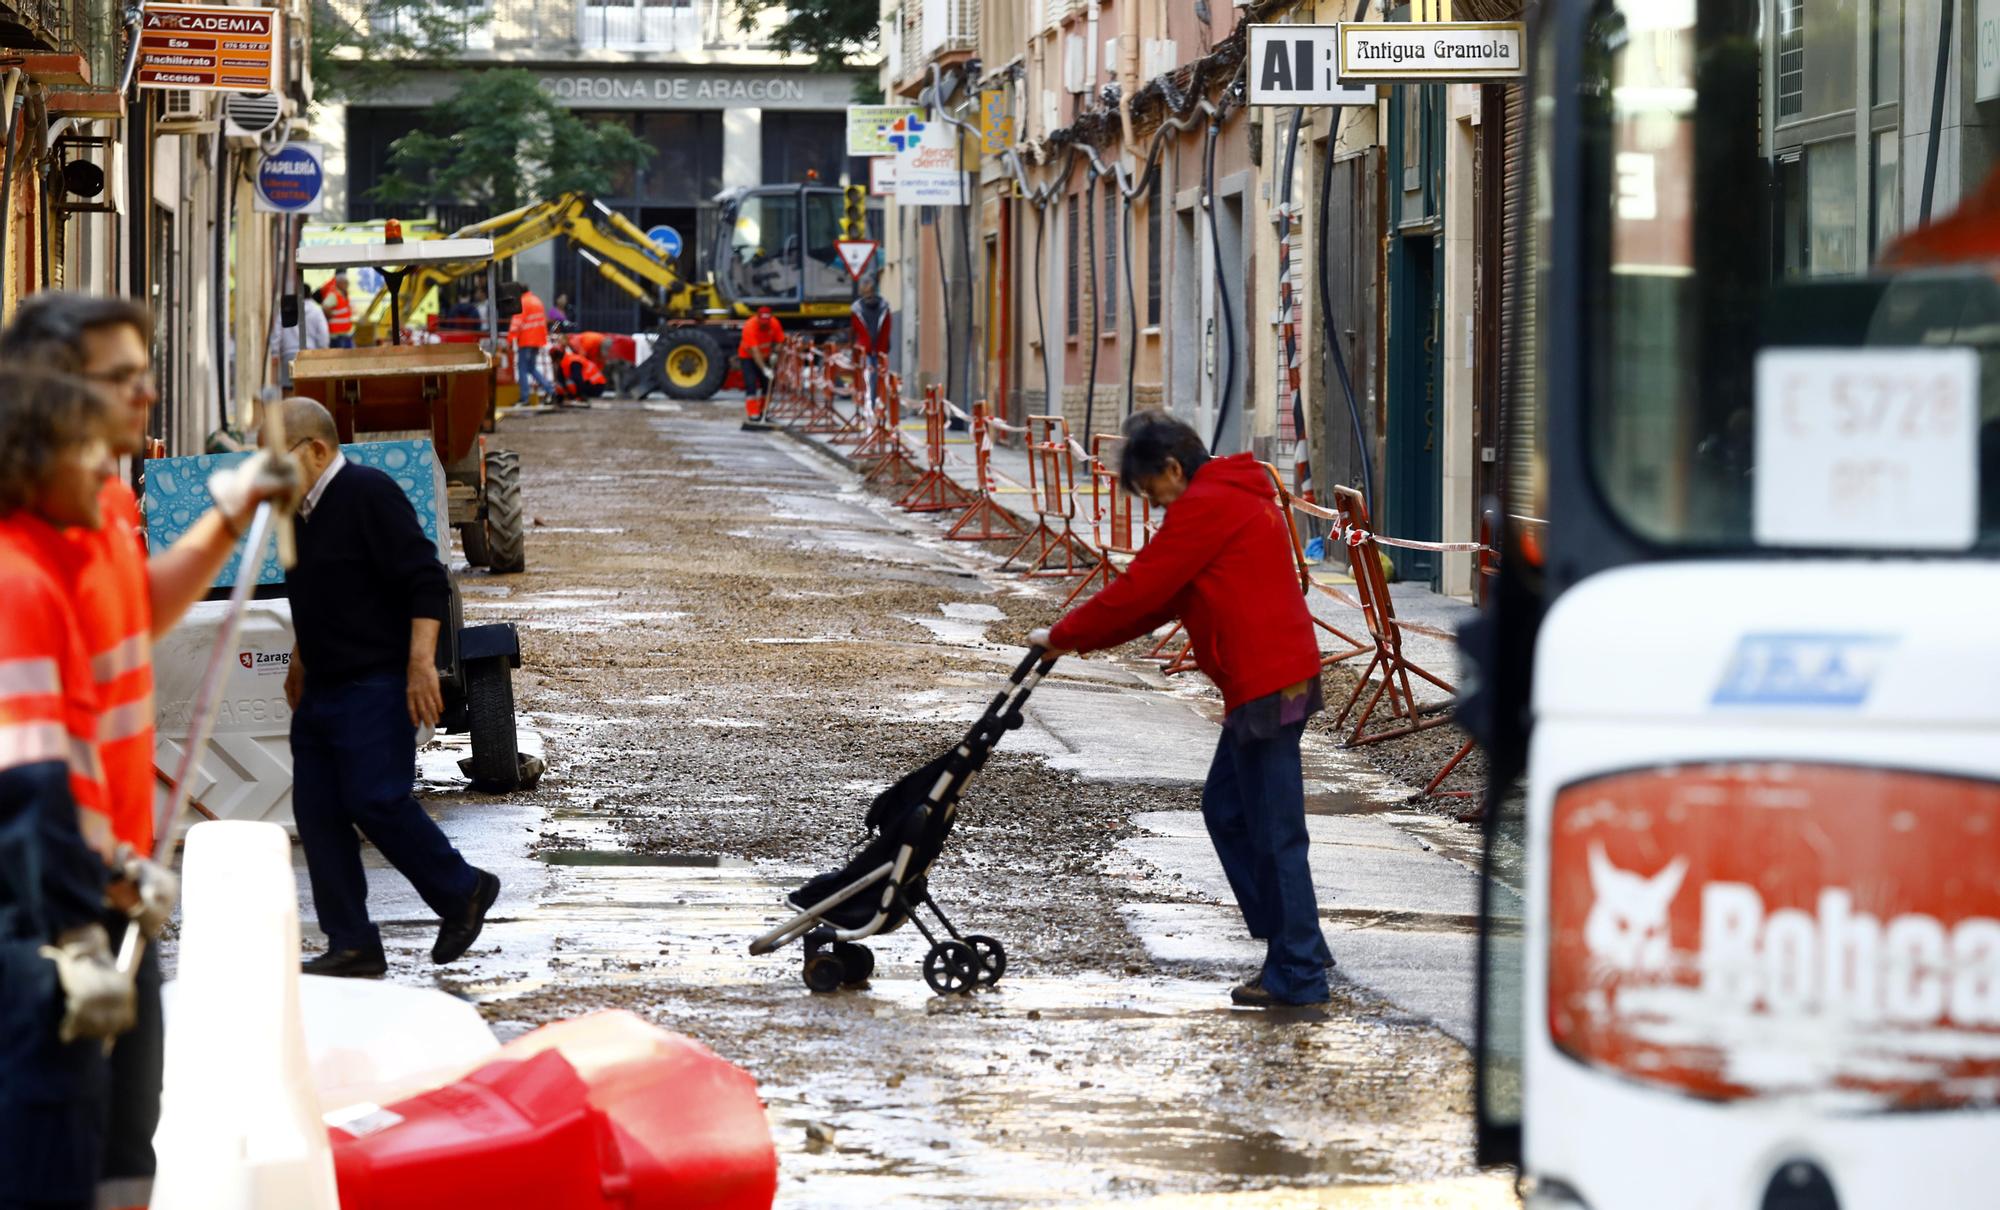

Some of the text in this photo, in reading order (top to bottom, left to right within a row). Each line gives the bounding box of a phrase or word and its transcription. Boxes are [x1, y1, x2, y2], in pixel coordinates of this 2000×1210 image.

[169, 38, 189, 48] Eso
[1357, 40, 1509, 62] Antigua Gramola
[146, 54, 211, 66] Bachillerato
[154, 72, 200, 83] Accesos
[538, 77, 803, 99] CORONA DE ARAGÓN
[264, 159, 316, 176] PAPELERÍA
[1700, 879, 2000, 1023] Bobca
